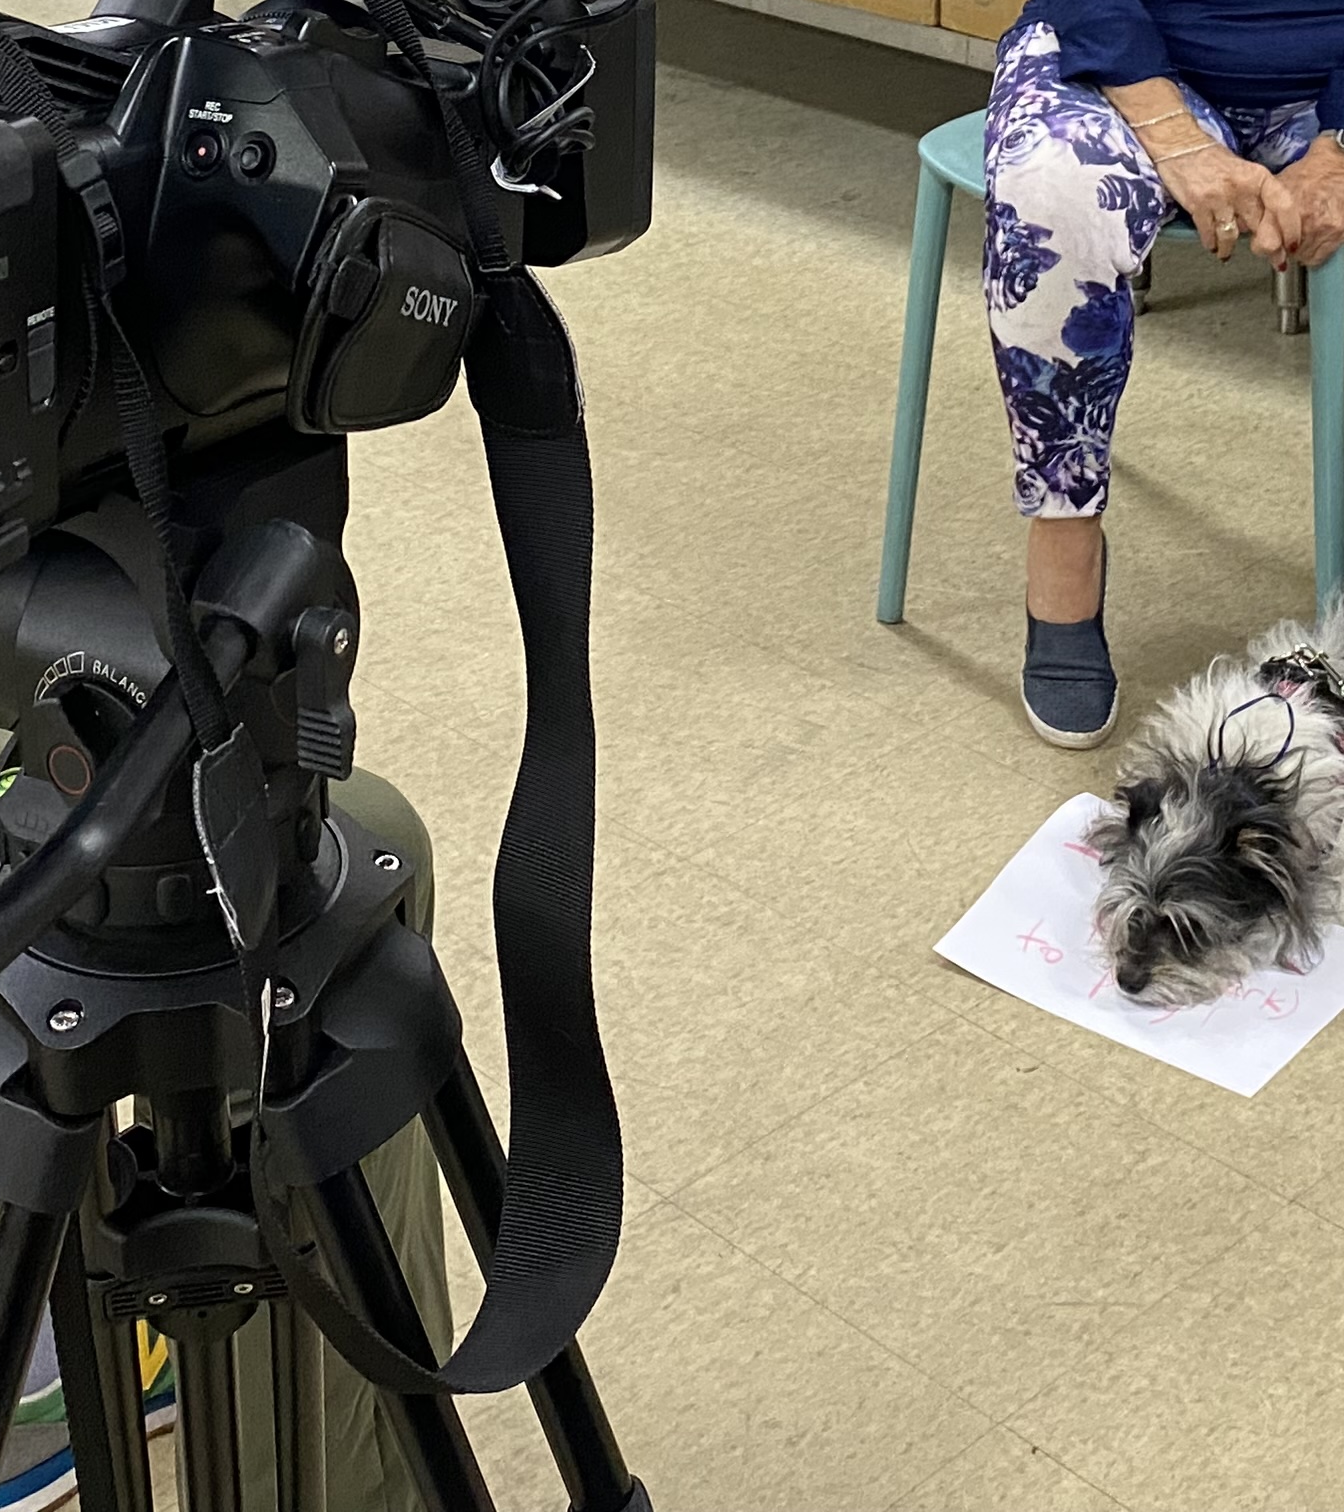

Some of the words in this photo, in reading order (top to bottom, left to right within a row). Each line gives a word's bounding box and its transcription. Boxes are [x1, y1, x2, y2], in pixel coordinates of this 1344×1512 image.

[188, 108, 234, 124] START/STOP
[204, 100, 222, 112] REC
[26, 305, 56, 327] REMOTE
[401, 286, 458, 328] SONY
[91, 658, 149, 709] BALANC
[1015, 918, 1066, 966] to
